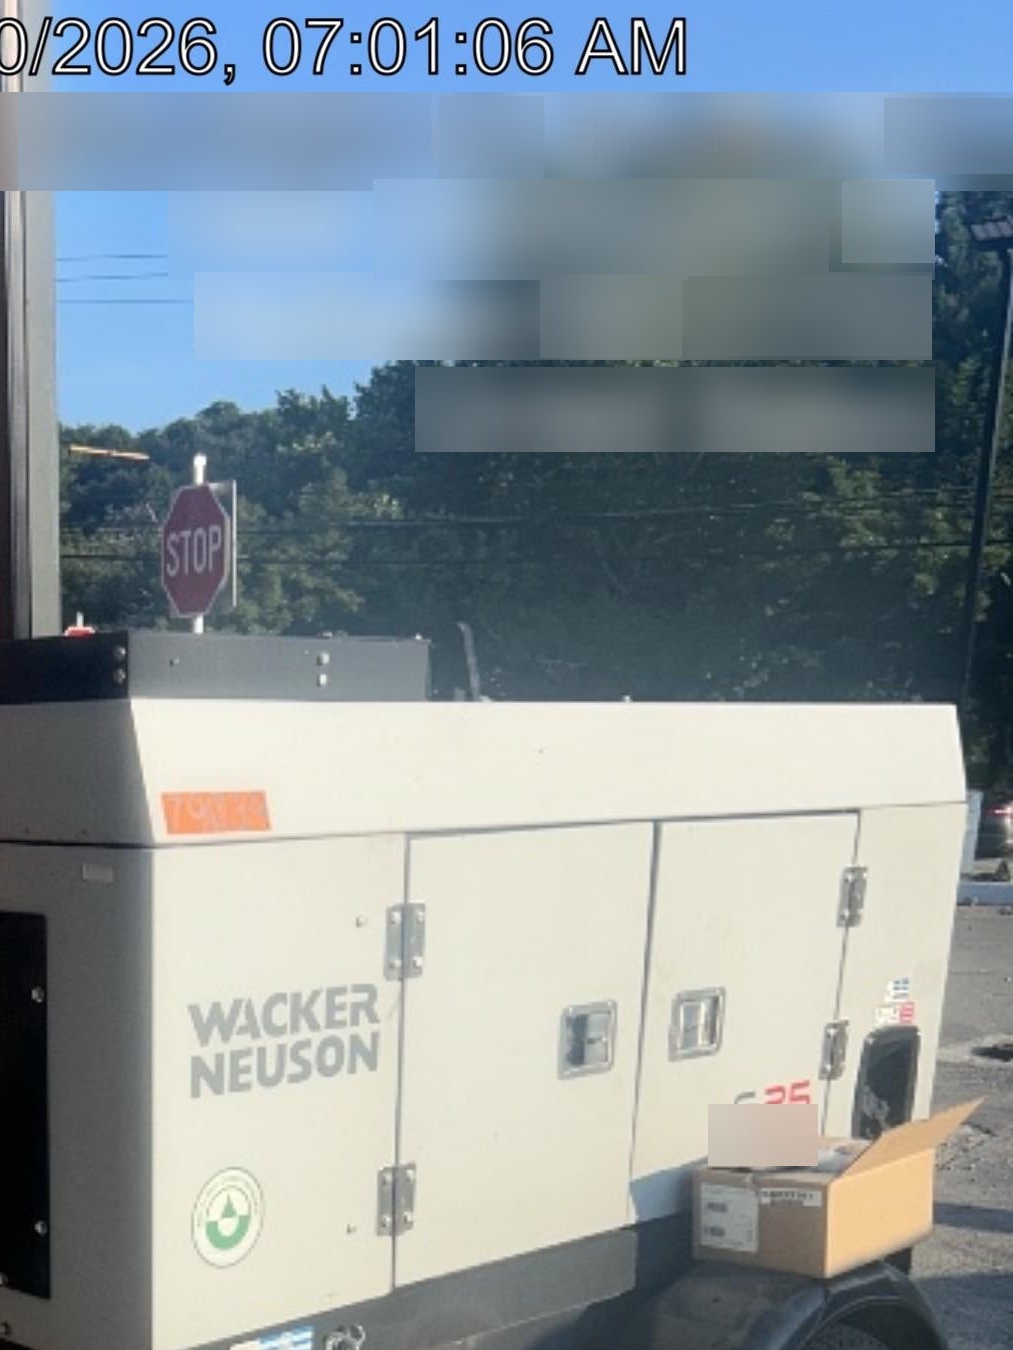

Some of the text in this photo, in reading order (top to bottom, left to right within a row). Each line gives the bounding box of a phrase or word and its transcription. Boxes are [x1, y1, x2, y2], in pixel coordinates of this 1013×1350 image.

[166, 524, 223, 577] STOP
[187, 983, 381, 1047] WACKER
[189, 1031, 381, 1099] NEUSON
